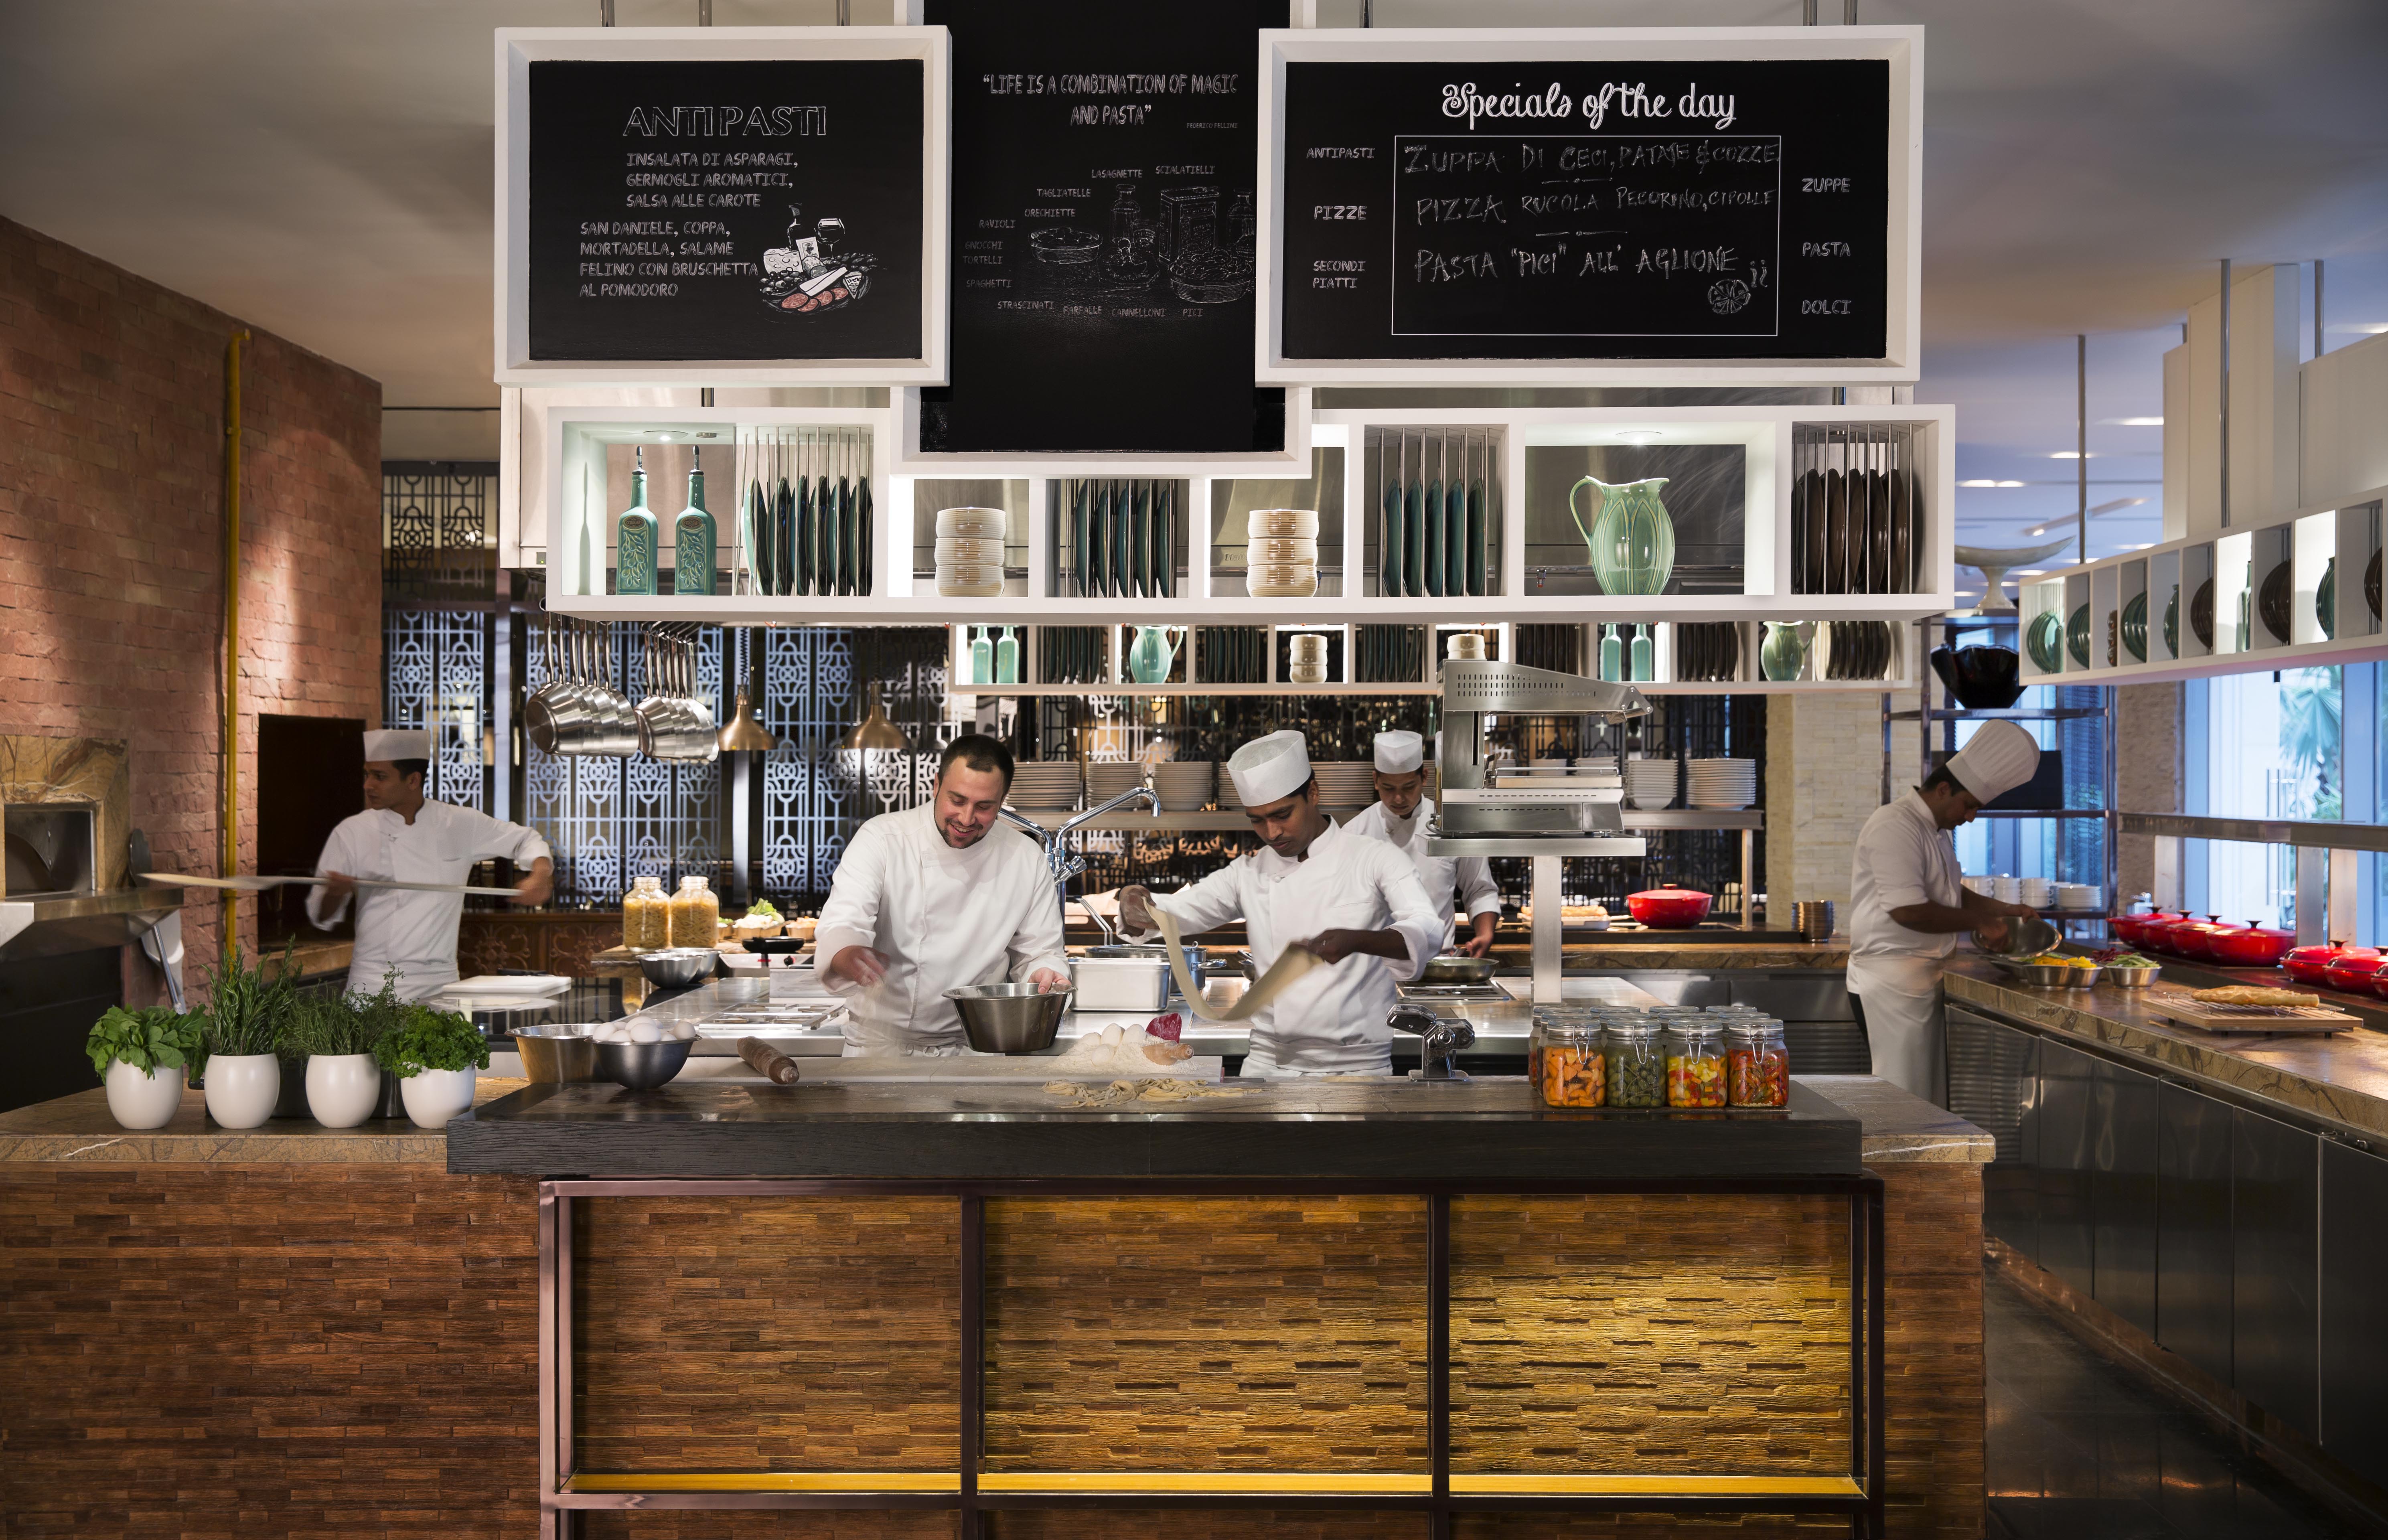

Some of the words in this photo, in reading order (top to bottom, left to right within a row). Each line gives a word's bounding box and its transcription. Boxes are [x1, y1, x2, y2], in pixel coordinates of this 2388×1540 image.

[983, 74, 1024, 94] “LIFE
[1027, 74, 1044, 94] IS
[1047, 75, 1057, 95] A
[1060, 74, 1166, 94] COMBINATION
[1169, 74, 1188, 94] OF
[1191, 74, 1239, 95] MAGIC
[1442, 82, 1573, 130] Specials
[1582, 82, 1615, 130] of
[1613, 82, 1672, 118] the
[1678, 82, 1737, 130] day
[622, 106, 826, 136] ANTIPASTI
[1070, 105, 1099, 125] AND
[1103, 104, 1151, 126] PASTA”
[626, 152, 698, 166] INSALATA
[702, 152, 721, 166] DI
[724, 152, 798, 168] ASPARAGI,
[1306, 147, 1375, 159] ANTIPASTI
[1404, 145, 1505, 174] ZUPPA
[1521, 143, 1543, 172] DI
[1091, 169, 1143, 178] LASAGNETTE
[1155, 165, 1215, 174] SCIALATIELLI
[626, 173, 700, 186] GERMOGLI
[703, 172, 793, 188] AROMATICI,
[1802, 178, 1849, 193] ZUPPE
[1036, 188, 1091, 197] TAGLIATELLE
[626, 193, 668, 207] SALSA
[671, 193, 705, 207] ALLE
[708, 193, 761, 207] CAROTE
[1024, 208, 1075, 217] ORECHIETTE
[1314, 205, 1367, 220] PIZZE
[1417, 195, 1507, 226] PIZZA
[1521, 194, 1598, 215] RUCOLA
[580, 222, 609, 235] SAN
[612, 221, 678, 237] DANIELE,
[683, 221, 730, 237] COPPA,
[979, 219, 1016, 229] RAVIOLI
[580, 241, 675, 258] MORTADELLA,
[679, 241, 734, 255] SALAME
[965, 241, 1003, 250] GNOCCHI
[1802, 242, 1851, 257] PASTA
[962, 255, 1003, 265] TORTELLI
[1313, 260, 1366, 272] SECONDI
[1414, 249, 1498, 282] PASTA
[1579, 244, 1622, 277] ALL'
[1635, 246, 1739, 280] AGLIONE
[580, 262, 635, 276] FELINO
[639, 263, 668, 276] CON
[672, 262, 758, 276] BRUSCHETTA
[579, 283, 597, 297] AL
[601, 283, 678, 297] POMODORO
[966, 279, 1012, 288] SPAGHETTI
[1313, 277, 1358, 289] PIATTI
[997, 300, 1055, 310] STRASCINATI
[1063, 306, 1102, 316] FARFALLE
[1802, 299, 1852, 314] DOLCI
[1112, 308, 1166, 317] CANNELLONI
[1183, 308, 1203, 317] PICI
